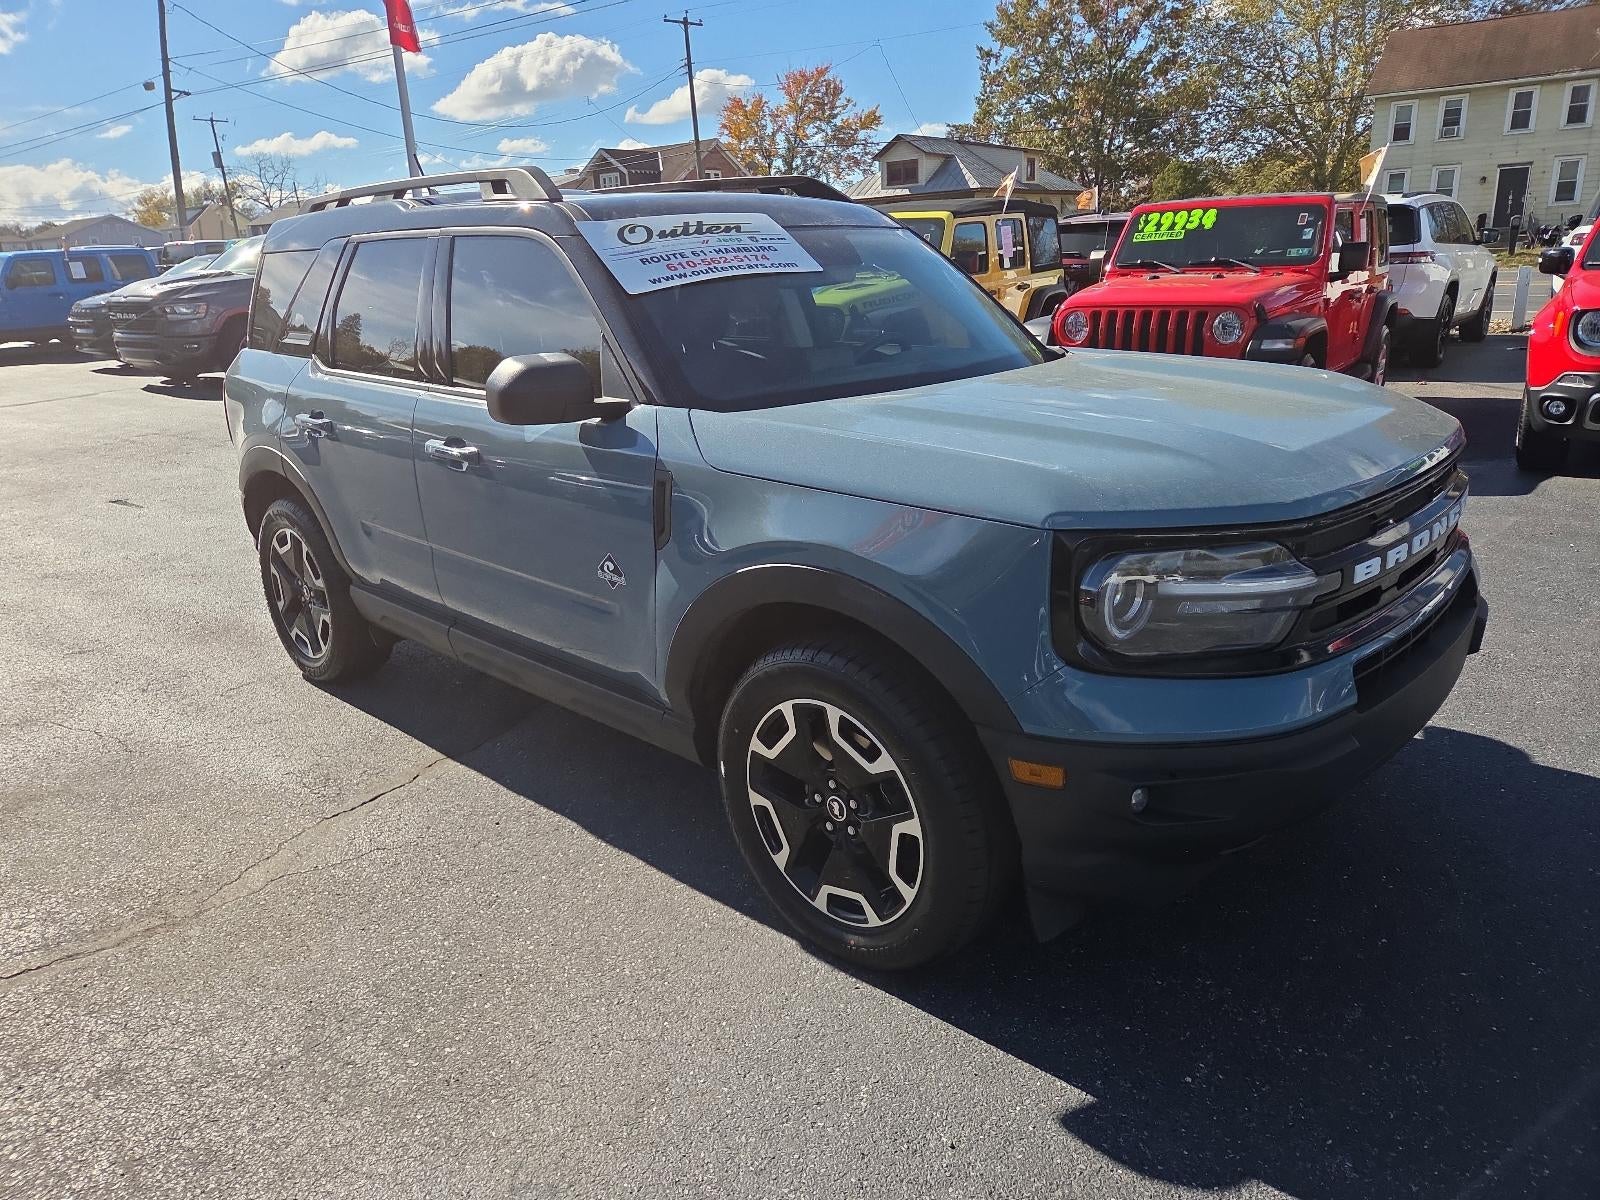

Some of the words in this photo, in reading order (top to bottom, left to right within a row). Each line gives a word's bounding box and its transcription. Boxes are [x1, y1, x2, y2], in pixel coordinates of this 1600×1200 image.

[1138, 208, 1218, 233] $29934
[617, 220, 761, 246] Outten
[1134, 231, 1183, 240] CERTIFIED
[639, 251, 689, 265] ROUTE
[712, 245, 779, 255] HAMBURG
[666, 254, 770, 272] 610-562-5174
[648, 260, 800, 285] www.outtencars.com
[115, 312, 137, 320] RAM
